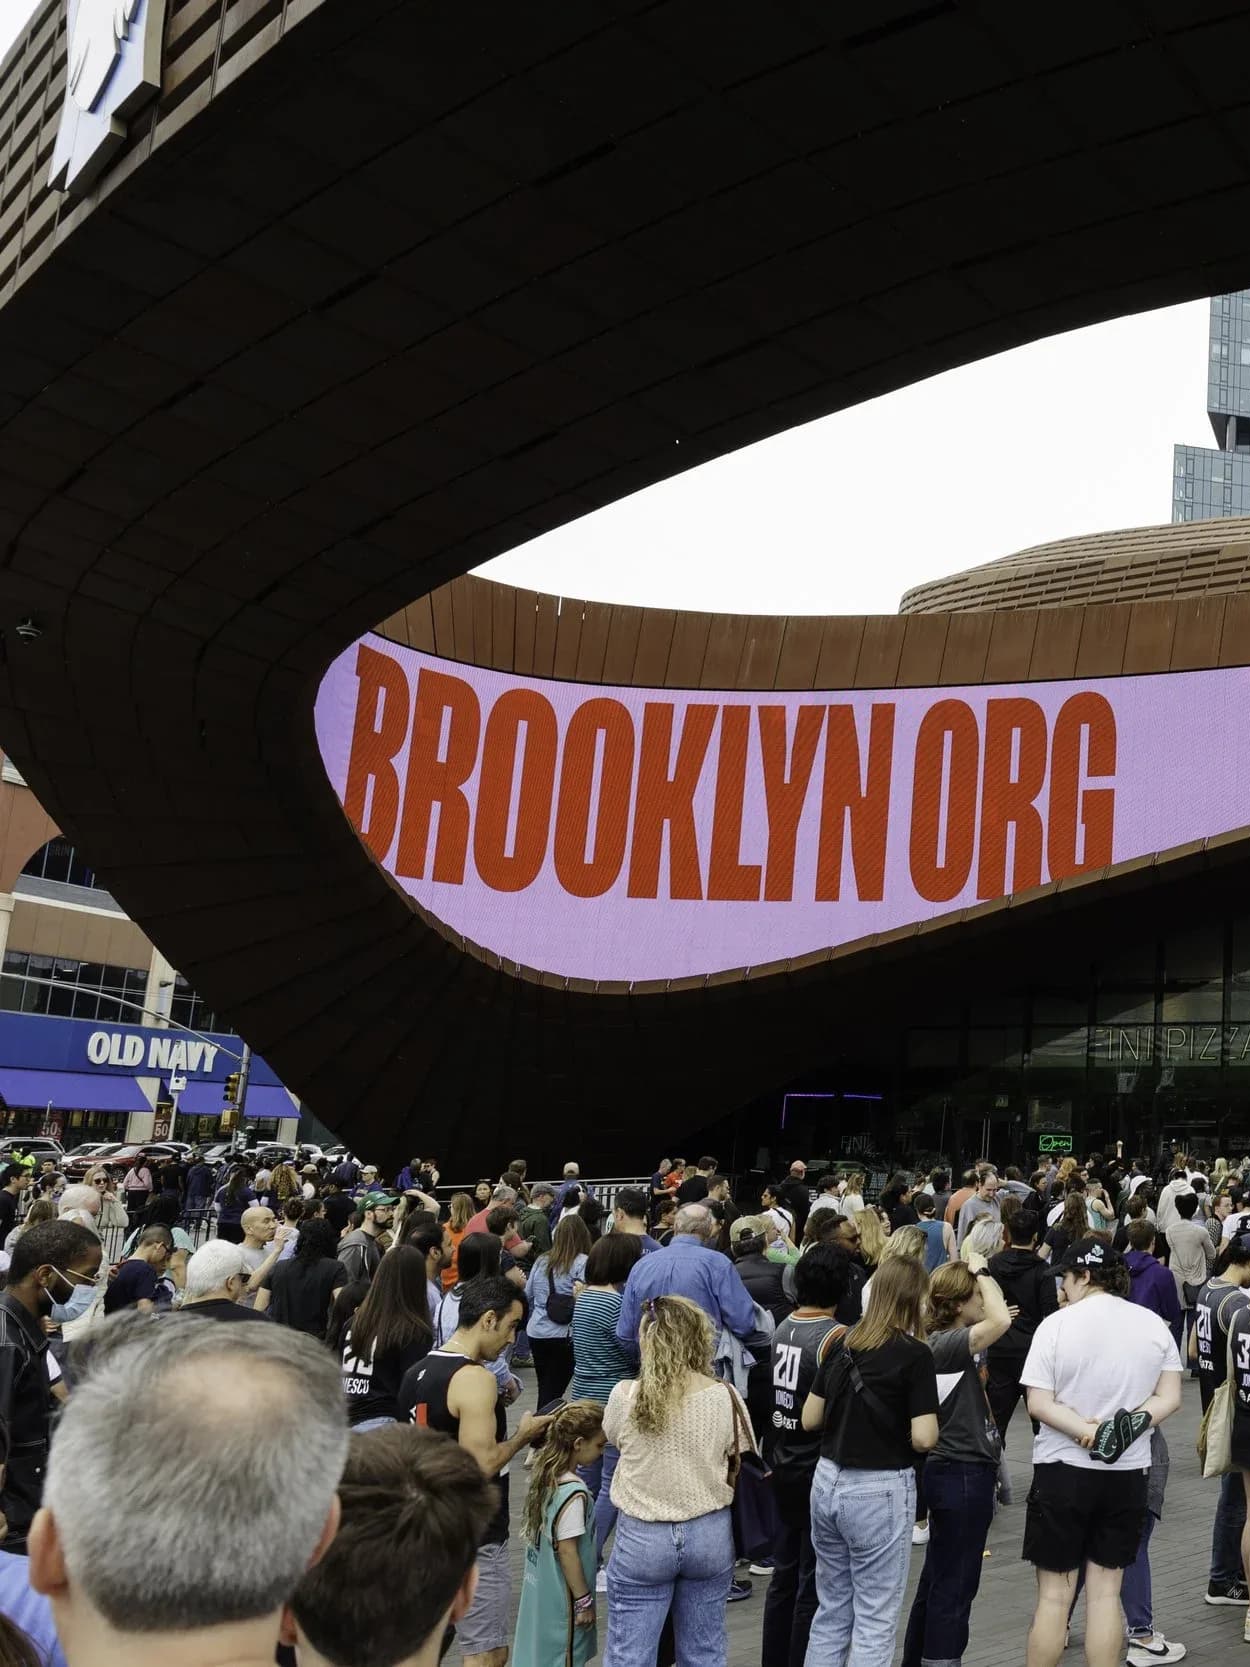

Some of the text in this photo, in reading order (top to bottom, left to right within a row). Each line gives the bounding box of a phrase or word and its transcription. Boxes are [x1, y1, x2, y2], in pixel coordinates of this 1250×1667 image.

[343, 643, 1117, 903] BROOKLYN ORG
[87, 1031, 220, 1073] OLD NAVY
[1041, 1136, 1071, 1151] Open
[1196, 1303, 1212, 1342] 20
[772, 1343, 802, 1391] 20
